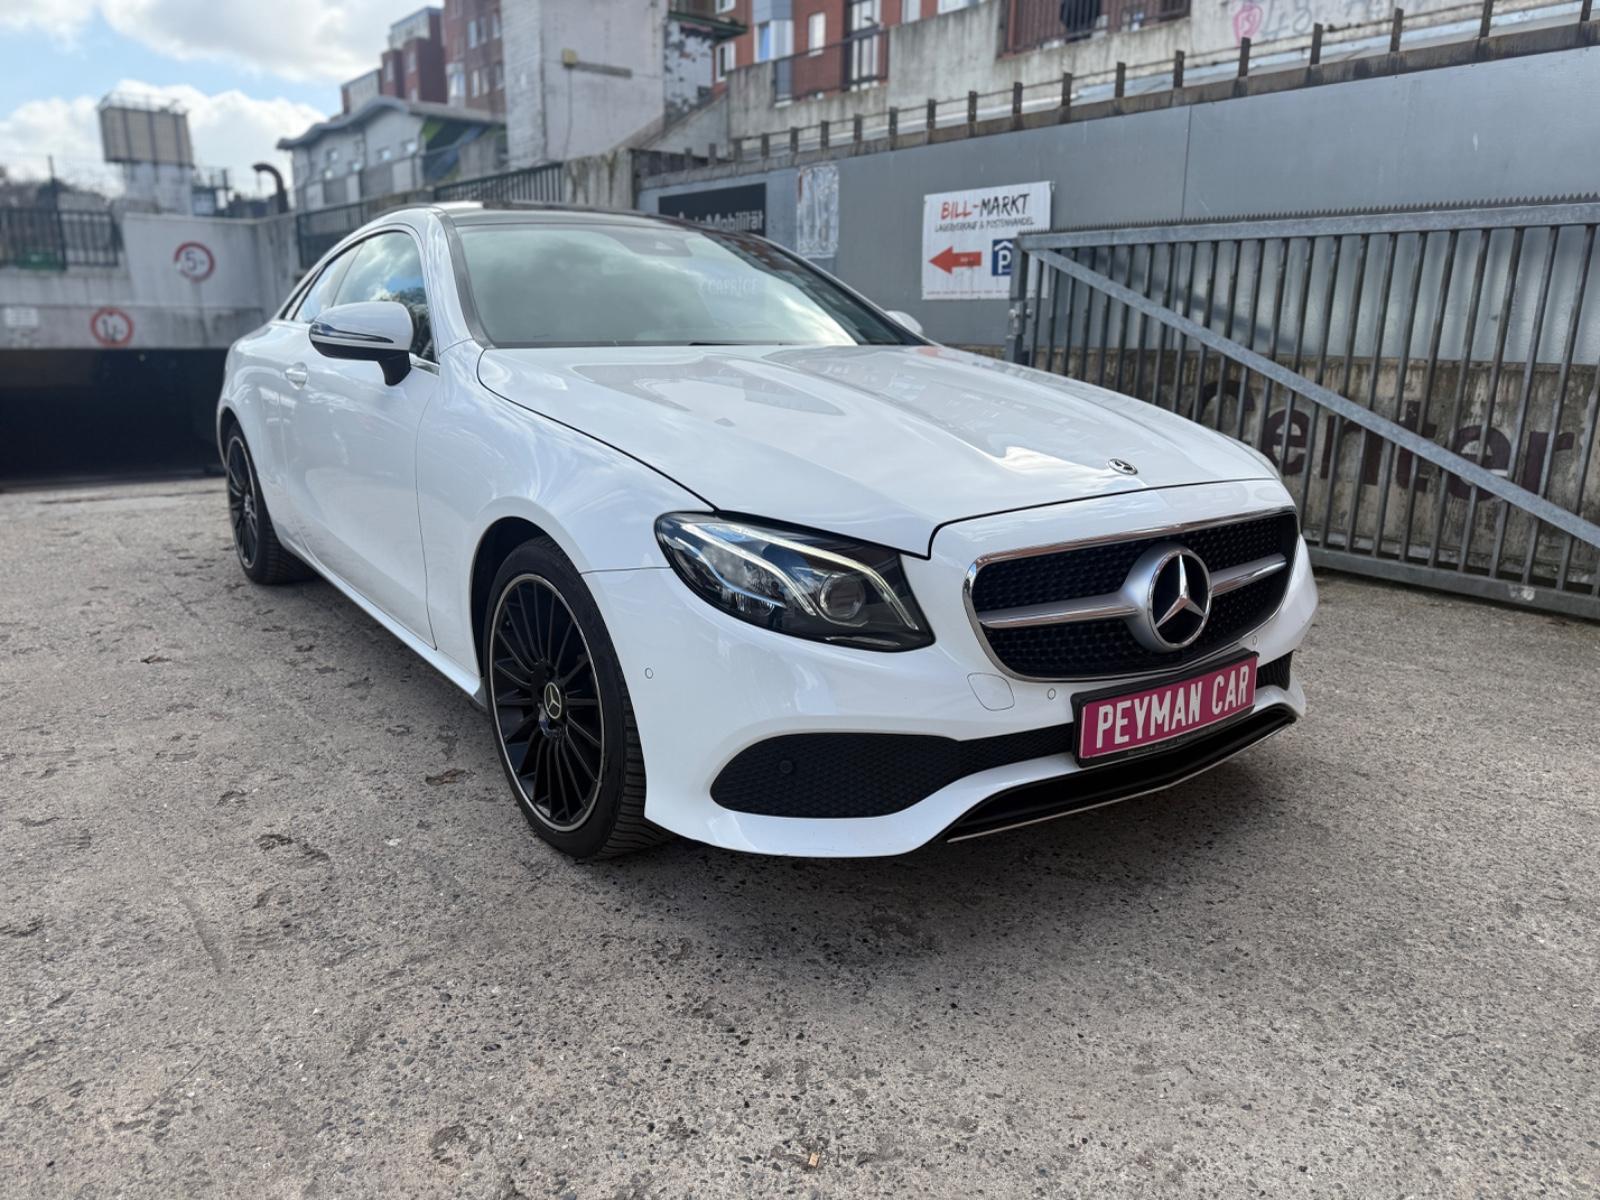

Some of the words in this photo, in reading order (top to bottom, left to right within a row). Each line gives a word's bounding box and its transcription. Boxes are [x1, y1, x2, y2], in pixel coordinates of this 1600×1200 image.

[678, 209, 764, 231] Mobilität
[998, 250, 1012, 274] P
[1096, 681, 1203, 749] PEYMAN
[1211, 664, 1250, 716] CAR
